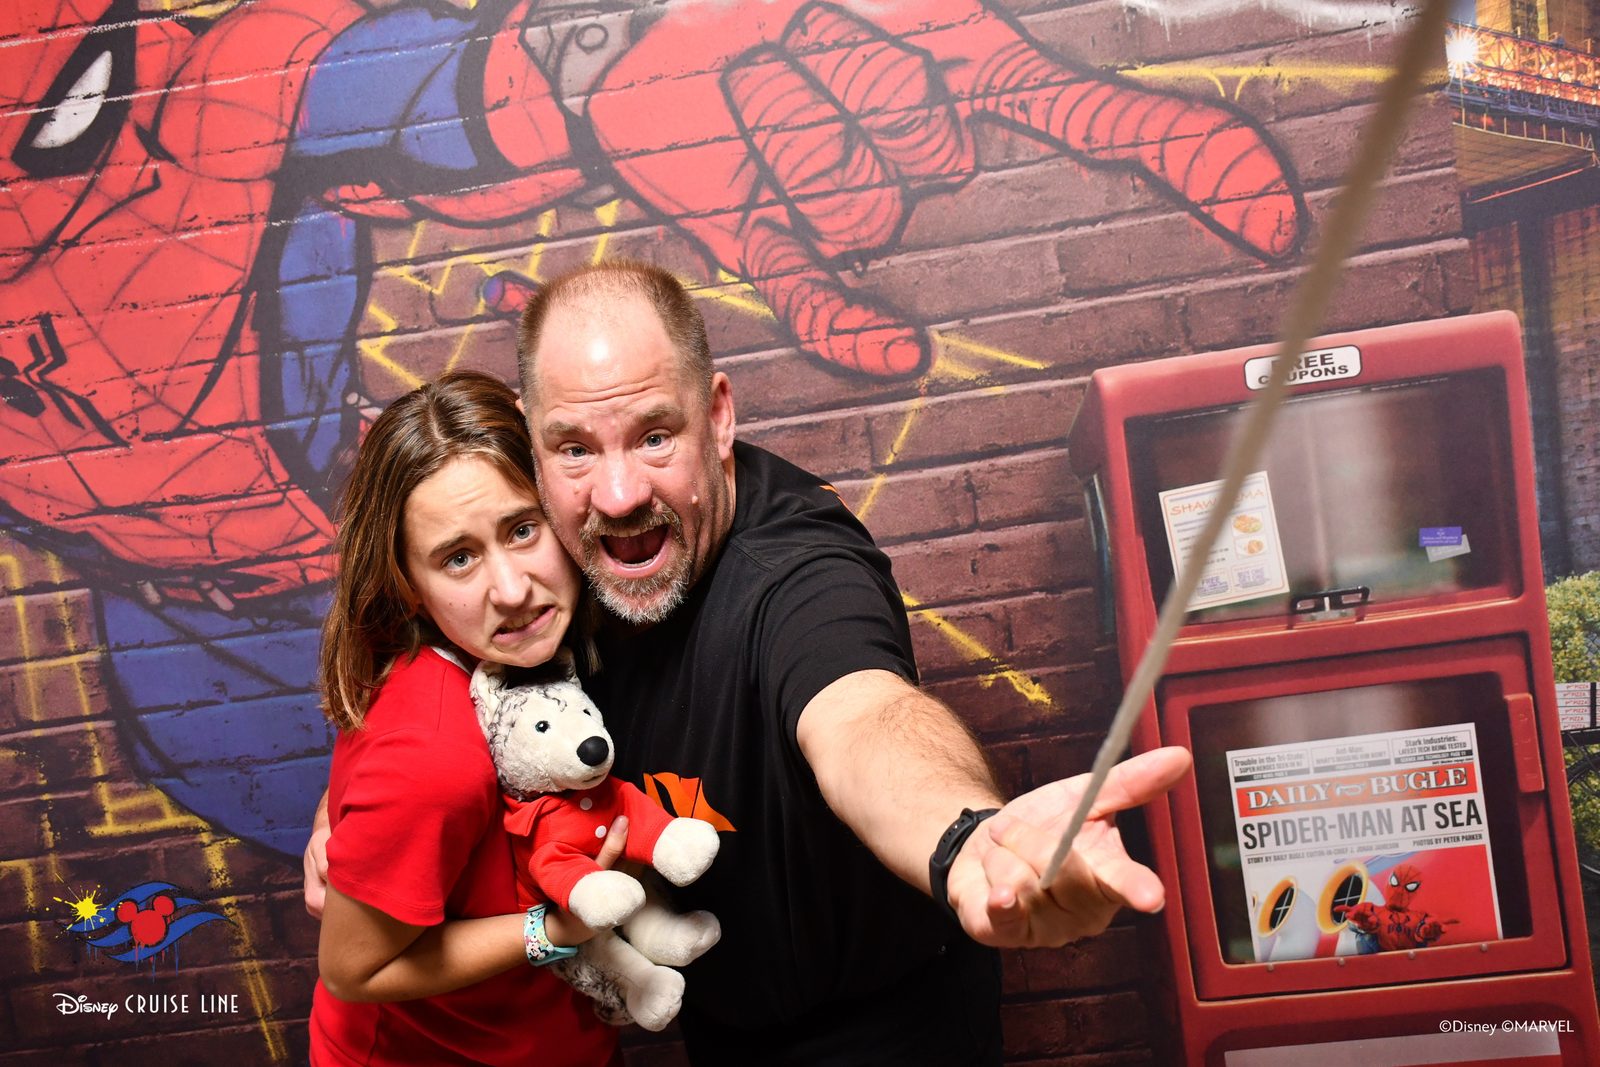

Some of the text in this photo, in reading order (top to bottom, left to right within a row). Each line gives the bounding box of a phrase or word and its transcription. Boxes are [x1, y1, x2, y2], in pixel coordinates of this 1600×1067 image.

[1258, 365, 1349, 385] CUPONS
[1405, 738, 1421, 747] Stark
[1432, 744, 1447, 752] BEING
[1448, 742, 1467, 750] TESTED
[1234, 757, 1257, 767] Trouble
[1266, 755, 1277, 764] the
[1239, 766, 1256, 774] SUPER
[1247, 767, 1467, 809] DAILY BUGLE
[1242, 799, 1482, 850] SPIDER-MAN AT SEA
[1413, 833, 1483, 847] PHOTOS BY PETER PARKER
[1247, 854, 1264, 865] STORY
[1265, 853, 1272, 863] BY
[1273, 851, 1288, 862] DAILY
[1289, 849, 1305, 860] BUGLE
